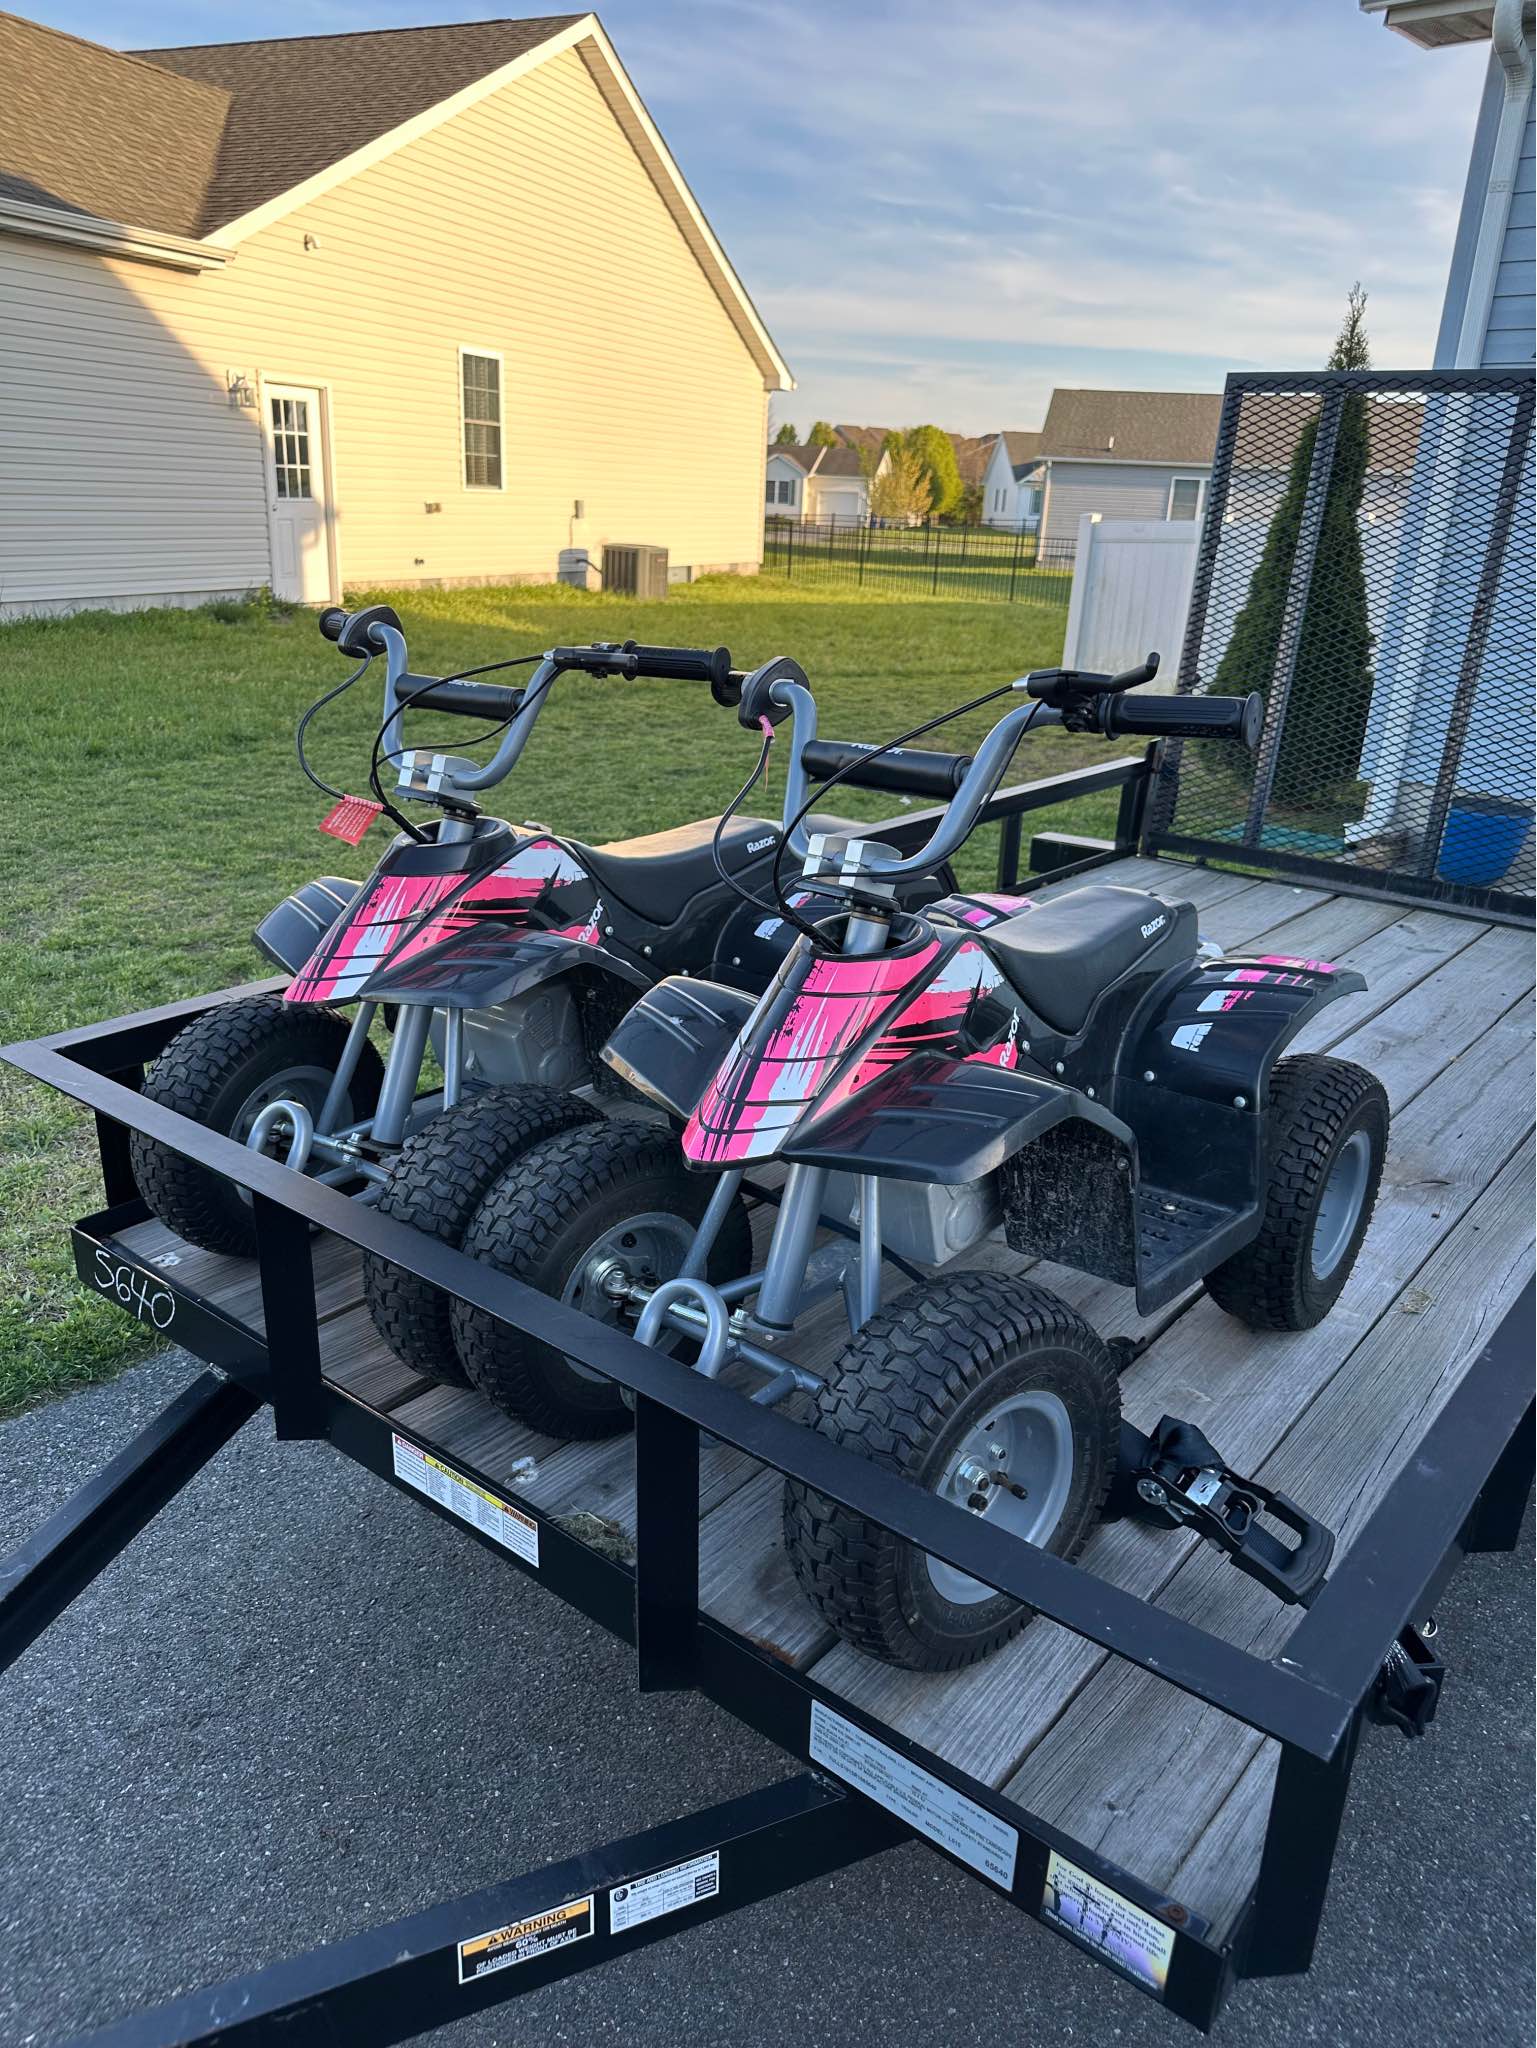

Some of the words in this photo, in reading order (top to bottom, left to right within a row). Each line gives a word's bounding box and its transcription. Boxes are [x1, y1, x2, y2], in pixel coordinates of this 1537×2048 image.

[94, 1249, 175, 1328] 5640
[501, 1909, 566, 1941] WARNING
[515, 1933, 538, 1949] 60%
[487, 1949, 516, 1965] LOADED
[518, 1938, 546, 1954] WEIGHT
[547, 1931, 566, 1943] MUST
